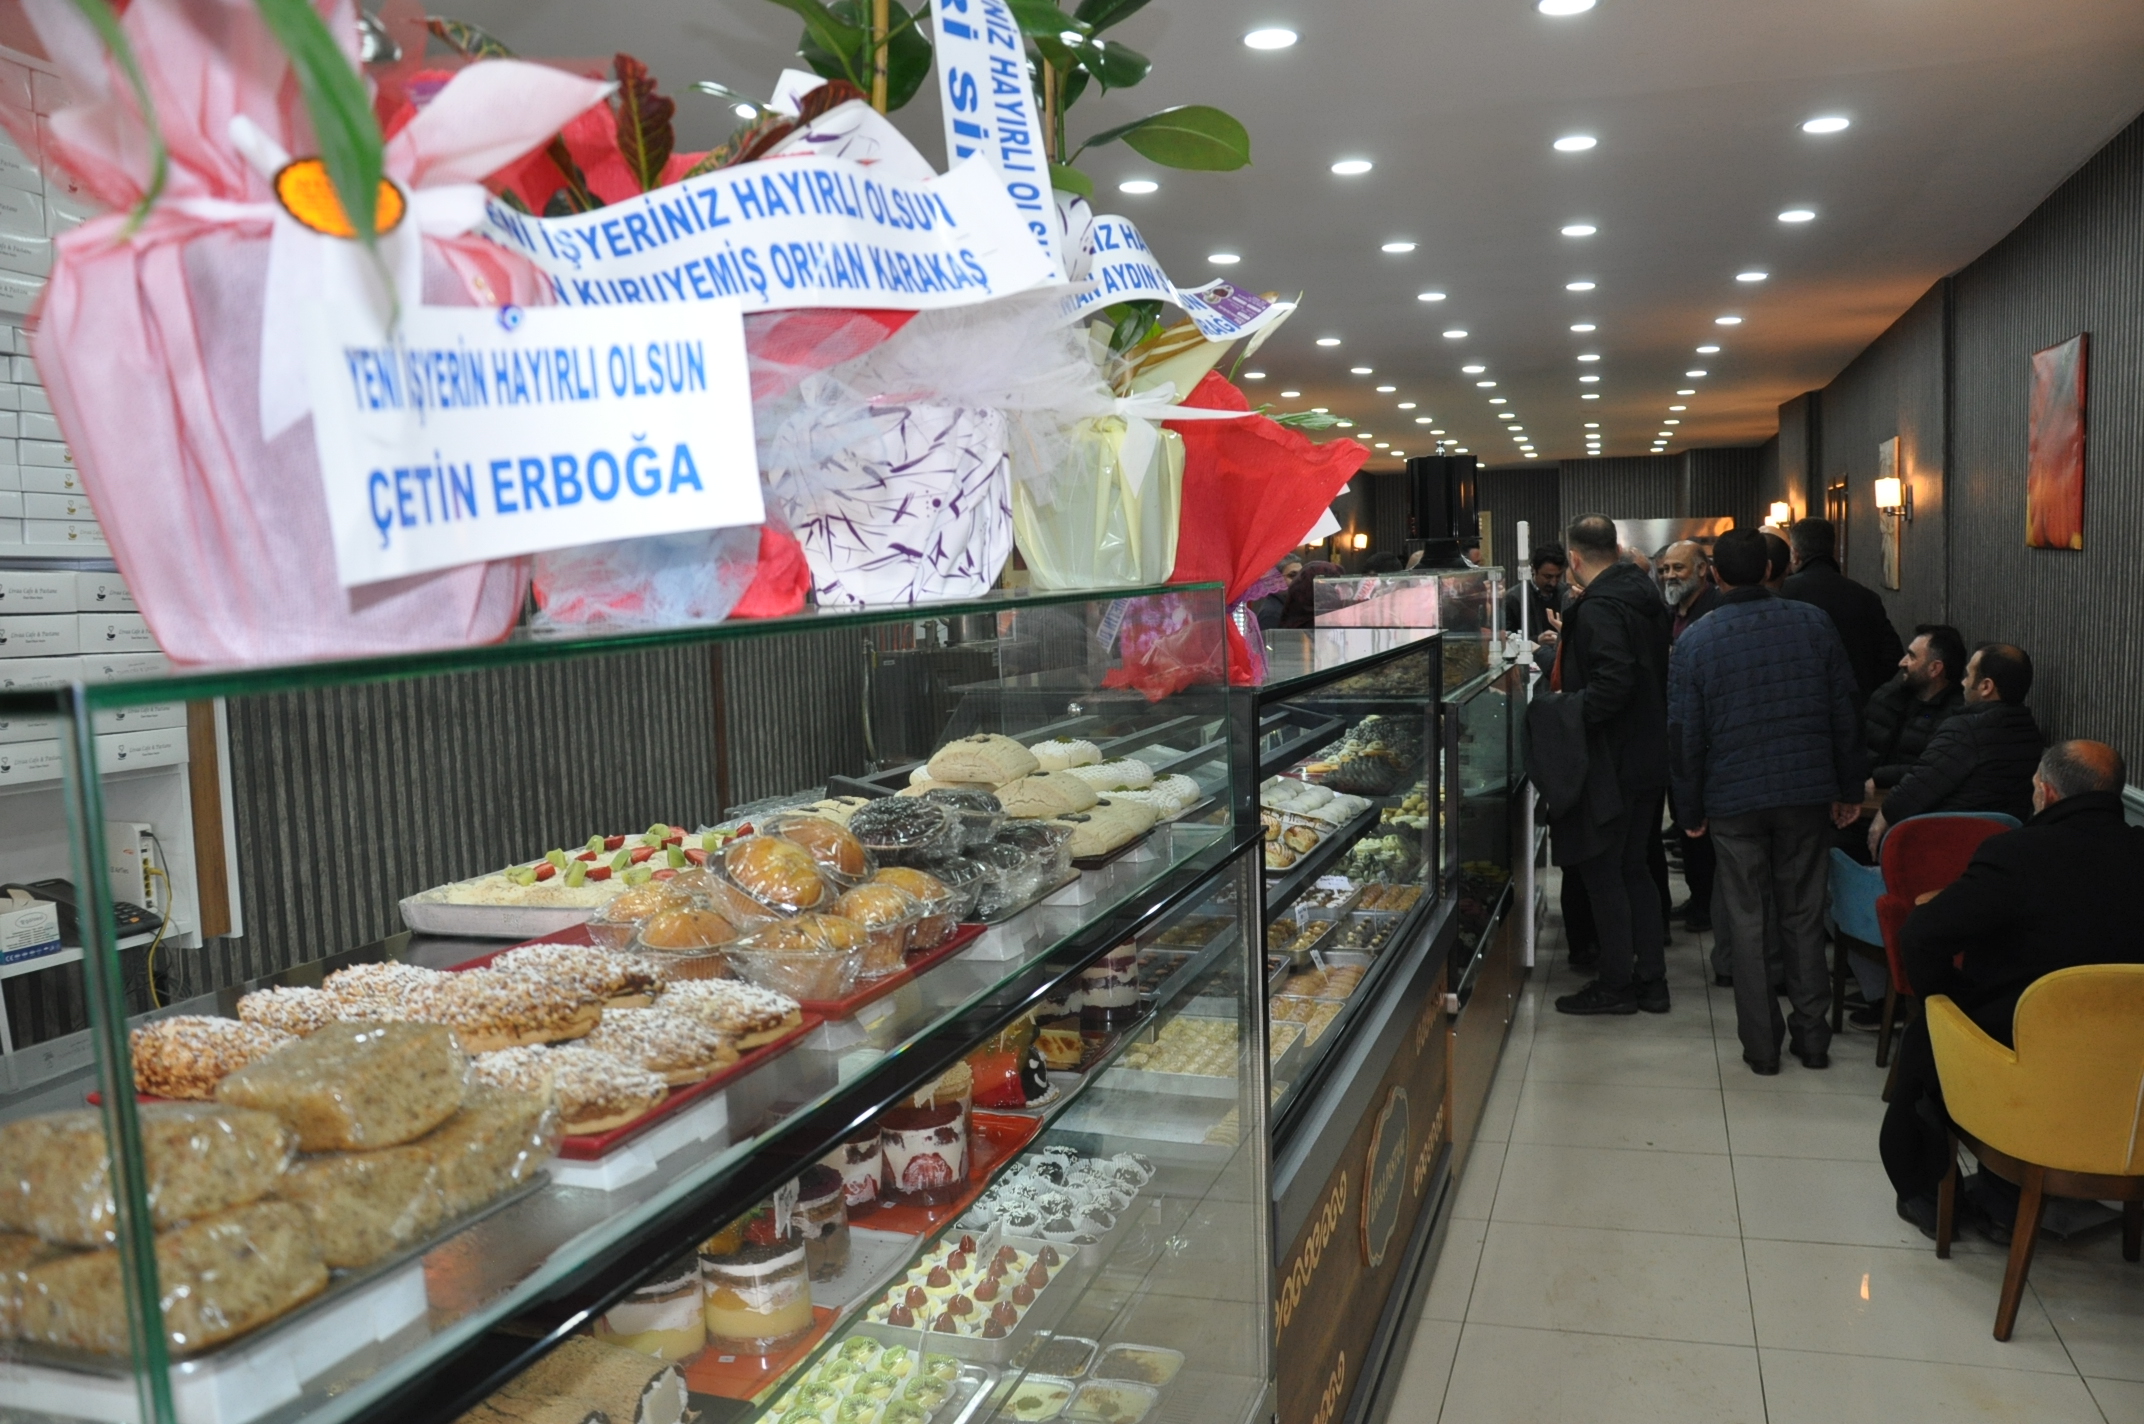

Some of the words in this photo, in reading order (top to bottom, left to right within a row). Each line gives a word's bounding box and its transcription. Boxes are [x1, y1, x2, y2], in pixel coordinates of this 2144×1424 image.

[989, 55, 1036, 172] HAYIRLI
[538, 183, 731, 270] İŞYERİNİZ
[730, 169, 864, 221] HAYIRLI
[864, 179, 957, 231] OLSUN
[572, 239, 769, 306] KURUYEMİŞ
[770, 242, 870, 290] ORHAN
[868, 244, 992, 295] KARAKAŞ
[1102, 262, 1160, 294] AYDIN
[491, 346, 599, 407] HAYIRLI
[607, 339, 706, 398] OLSUN
[368, 448, 478, 550] ÇETİN
[489, 432, 705, 515] ERBOĞA
